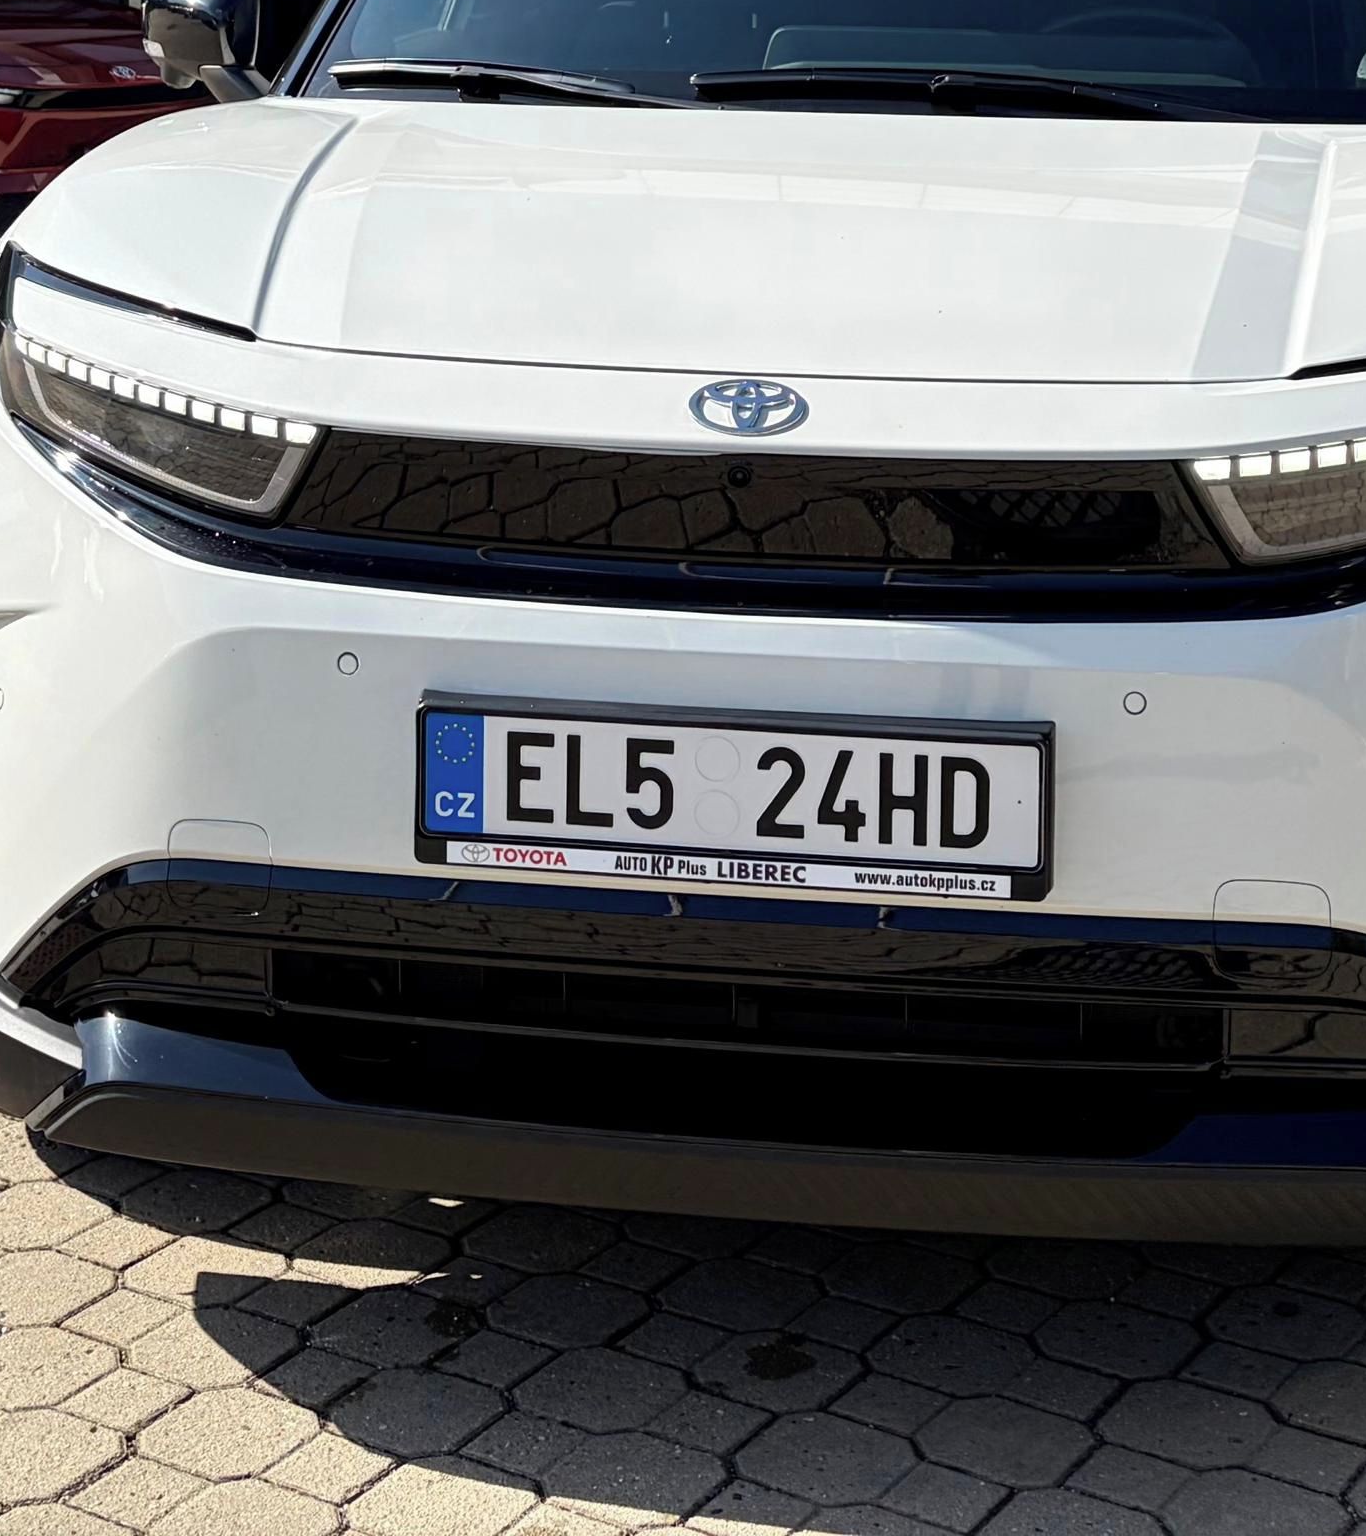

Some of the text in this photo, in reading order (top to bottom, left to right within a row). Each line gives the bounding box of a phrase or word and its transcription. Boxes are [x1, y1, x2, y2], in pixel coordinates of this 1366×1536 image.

[434, 790, 476, 820] CZ
[505, 730, 991, 849] EL5 24HD
[492, 847, 996, 892] TOYOTA AUTO KP Plus LIBEREC www.autokpplus.cz
